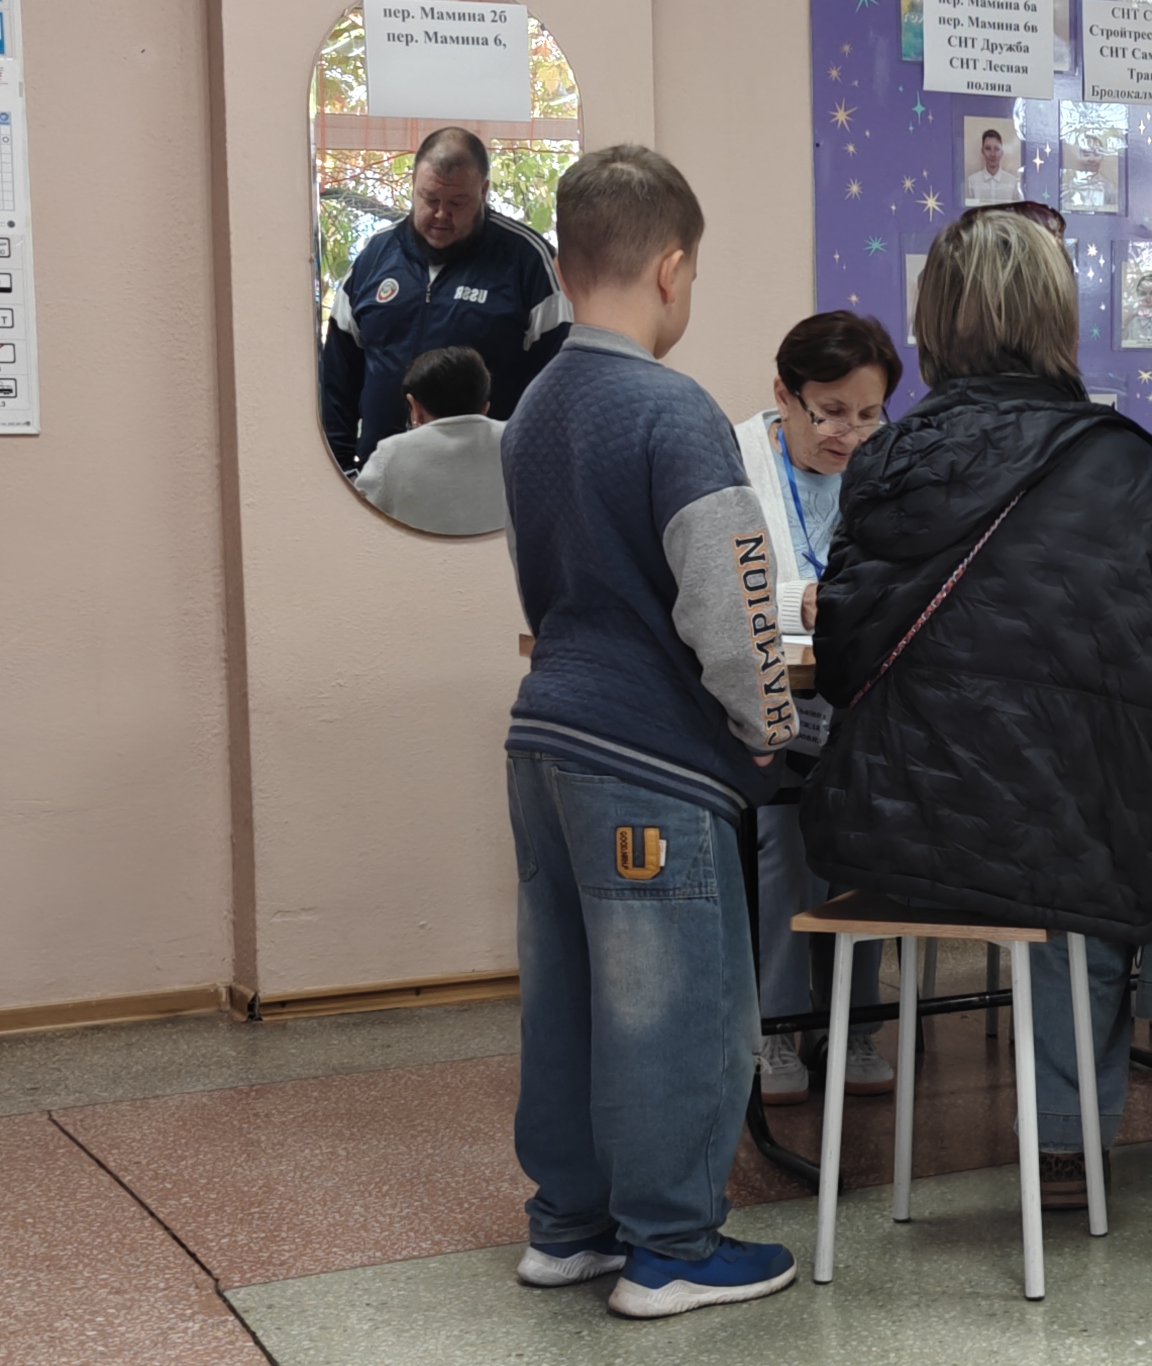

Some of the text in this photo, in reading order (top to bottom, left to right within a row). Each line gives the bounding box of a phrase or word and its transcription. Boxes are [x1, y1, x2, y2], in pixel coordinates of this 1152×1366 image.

[383, 6, 507, 23] пер. Мамина 2б
[1023, 0, 1037, 13] 6а
[1111, 6, 1139, 21] СНТ
[938, 14, 1038, 34] пер. Мамина 6в
[386, 31, 507, 49] пер. Мамина 6,
[947, 35, 1030, 55] СНТ Дружба
[1099, 45, 1128, 59] СНТ
[949, 57, 1029, 75] СНТ Лесная
[966, 79, 1012, 93] поляна
[733, 531, 797, 749] CHAMPION
